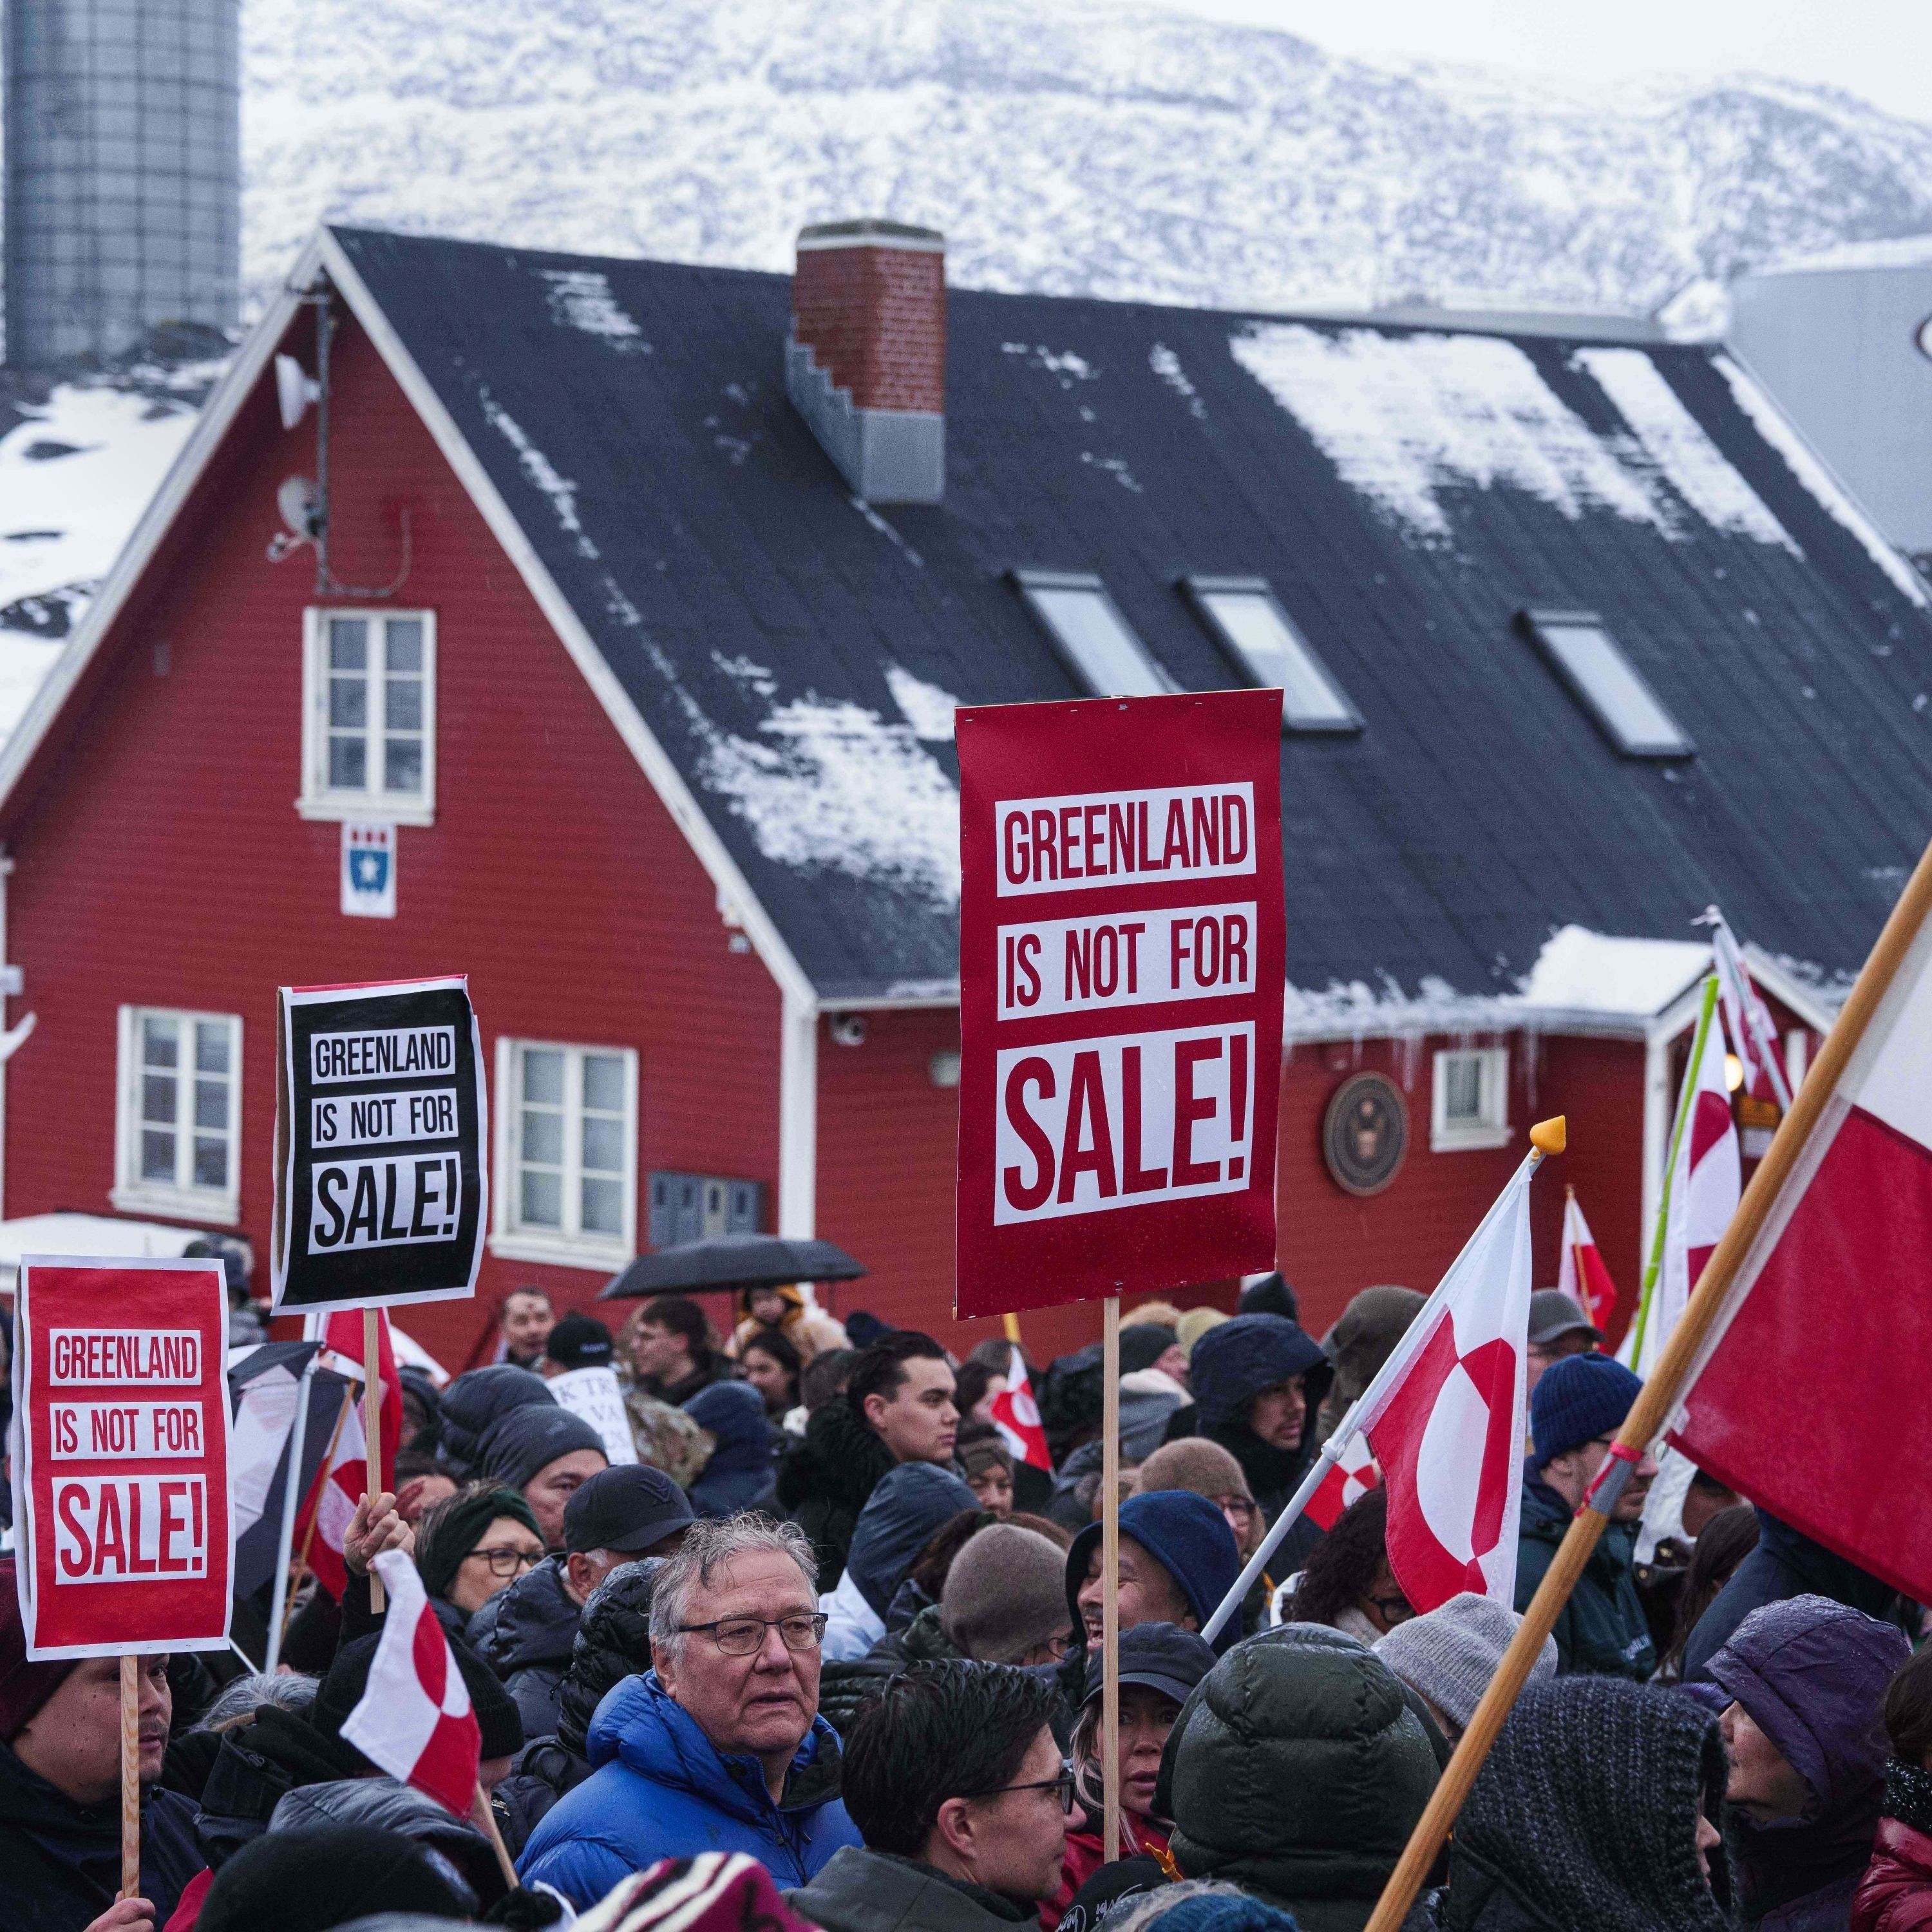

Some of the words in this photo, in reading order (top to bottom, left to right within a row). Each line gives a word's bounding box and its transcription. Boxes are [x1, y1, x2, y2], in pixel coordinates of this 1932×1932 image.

[1004, 794, 1248, 885] GREENLAND
[1005, 933, 1041, 1009] IS
[1065, 922, 1146, 1001] NOT
[1170, 914, 1248, 990] FOR
[315, 1032, 451, 1078] GREENLAND
[316, 1103, 337, 1142] IS
[350, 1099, 397, 1139] NOT
[410, 1095, 454, 1135] FOR
[1003, 1034, 1247, 1211] SALE!
[314, 1158, 457, 1247] SALE!
[55, 1335, 197, 1379] GREENLAND
[55, 1408, 79, 1454] IS
[90, 1408, 140, 1452] NOT
[153, 1408, 200, 1452] FOR
[58, 1481, 203, 1578] SALE!
